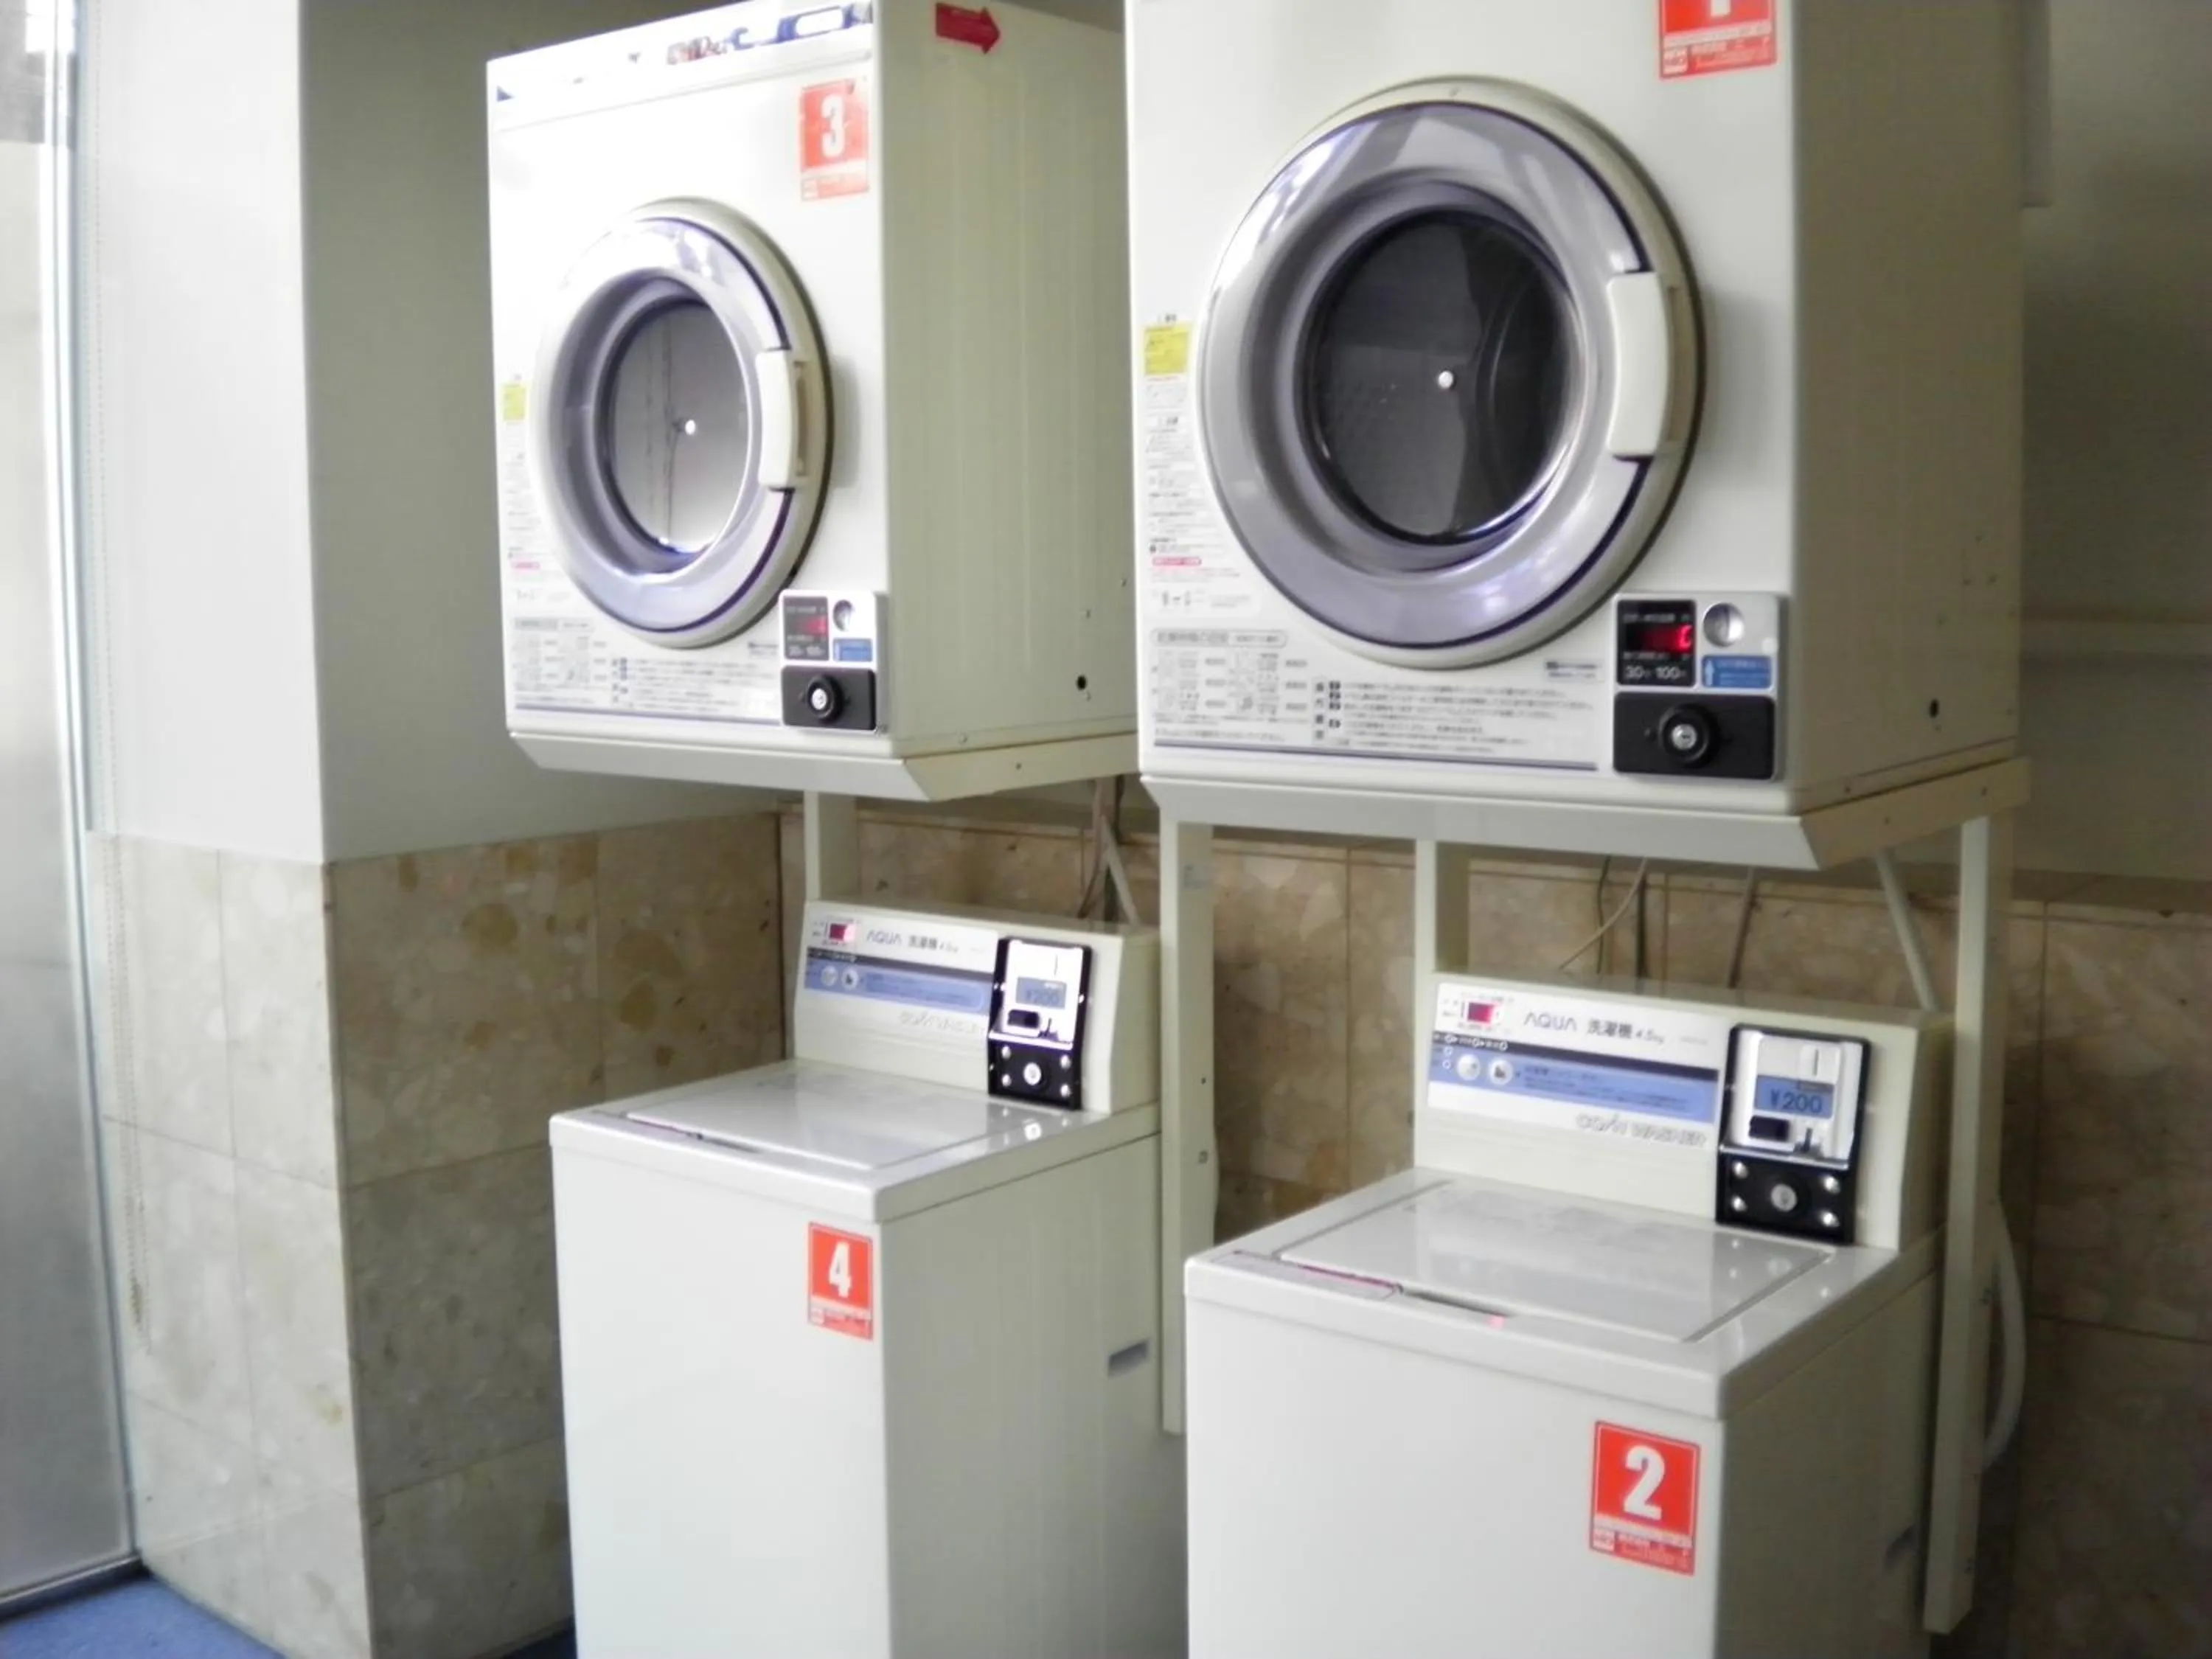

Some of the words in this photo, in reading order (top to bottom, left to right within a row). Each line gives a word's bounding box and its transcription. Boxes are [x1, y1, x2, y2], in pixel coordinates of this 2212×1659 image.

[821, 91, 846, 158] 3
[866, 929, 902, 945] AQUA
[1523, 1010, 1577, 1032] AQUA
[1587, 1018, 1633, 1040] 洗濯機
[1770, 1088, 1823, 1114] ¥200
[829, 1240, 853, 1298] 4
[1624, 1444, 1666, 1520] 2
